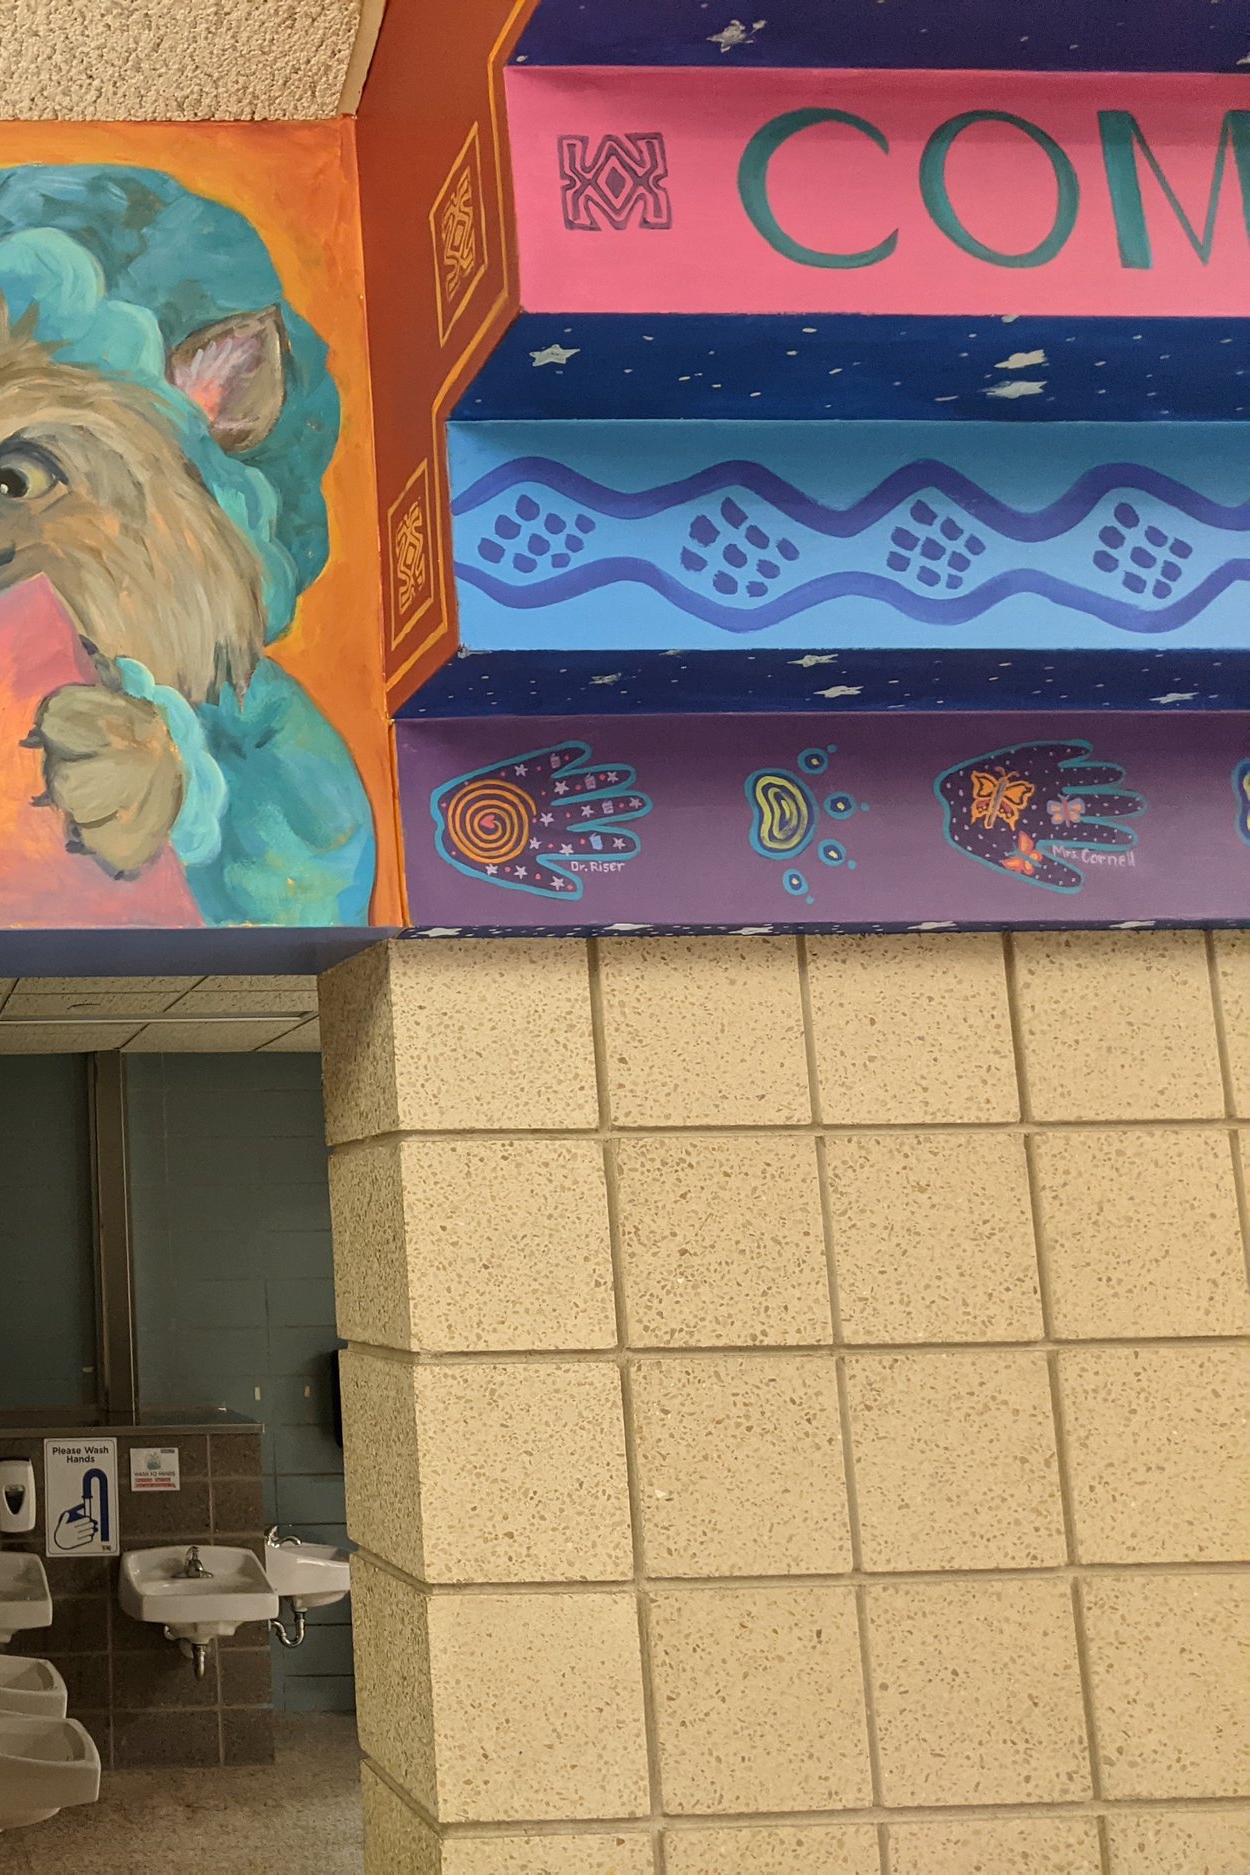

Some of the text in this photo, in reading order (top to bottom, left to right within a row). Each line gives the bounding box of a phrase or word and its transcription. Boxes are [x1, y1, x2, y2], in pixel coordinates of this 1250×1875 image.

[1081, 848, 1136, 868] Cornell
[570, 860, 589, 872] Dr.
[52, 1445, 110, 1456] Please Wash
[66, 1455, 96, 1464] Hands
